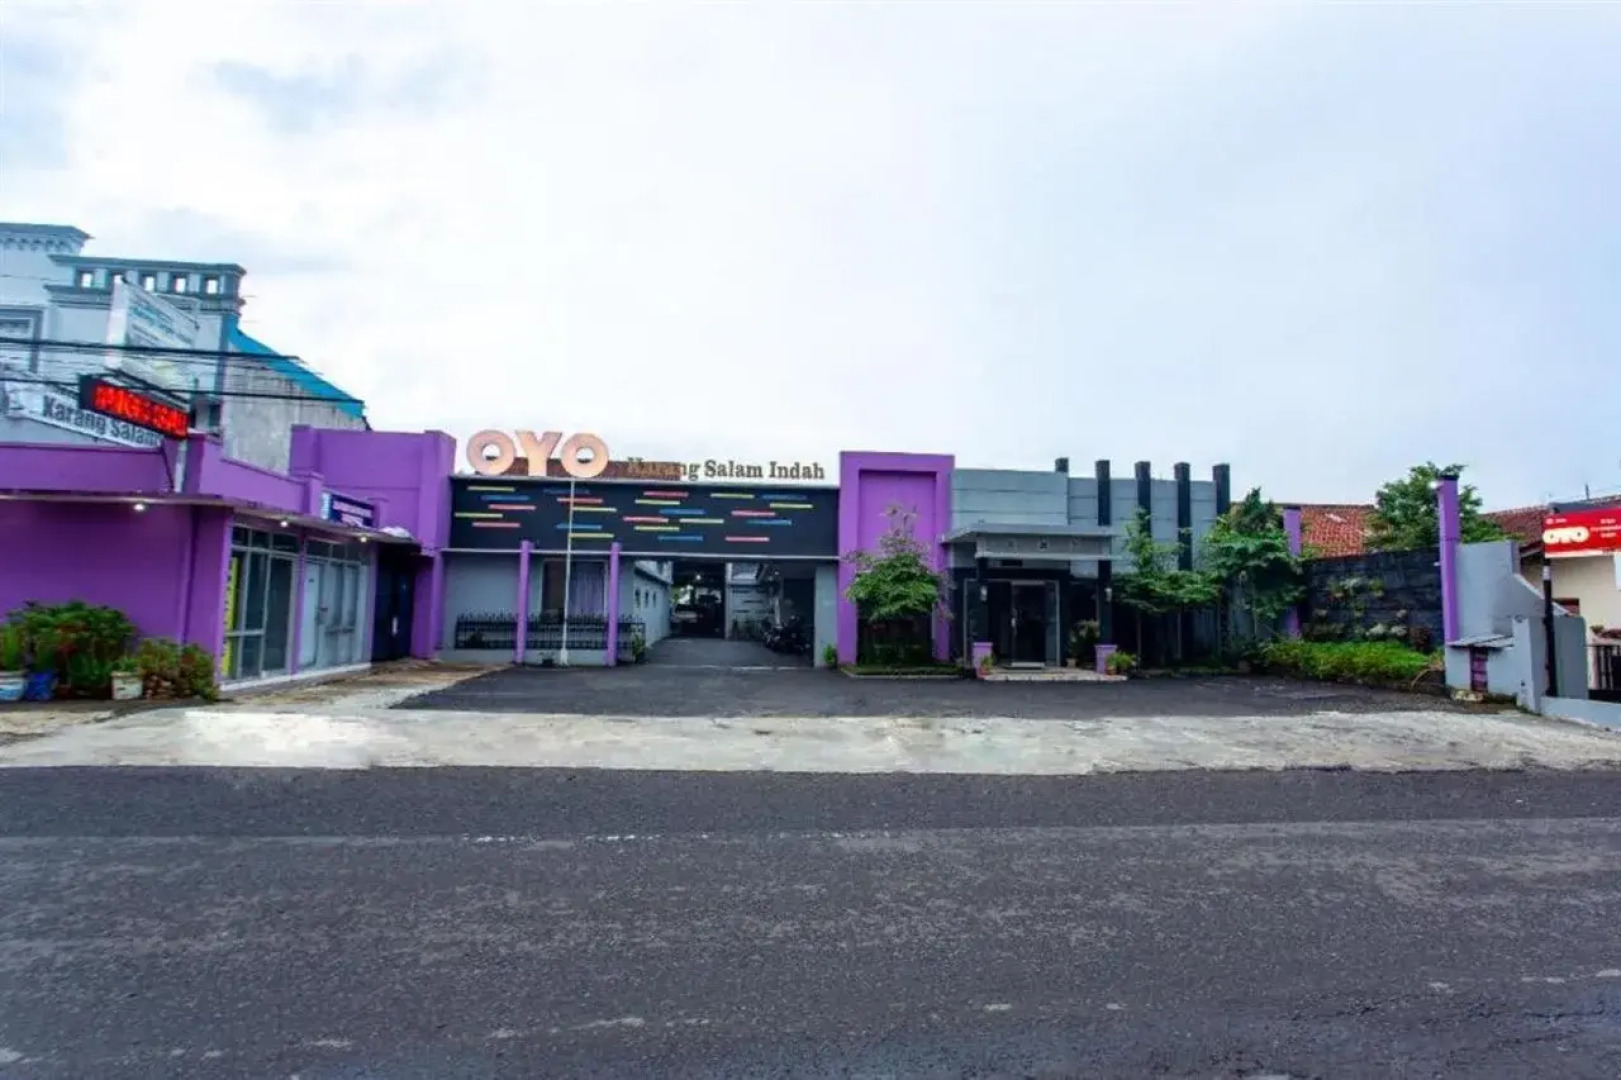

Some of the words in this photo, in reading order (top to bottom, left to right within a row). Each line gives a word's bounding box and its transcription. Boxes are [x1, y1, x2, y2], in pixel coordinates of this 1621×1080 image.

[43, 394, 106, 435] Karang
[466, 429, 610, 478] OYO
[704, 459, 763, 479] Salam
[769, 461, 825, 480] Indah
